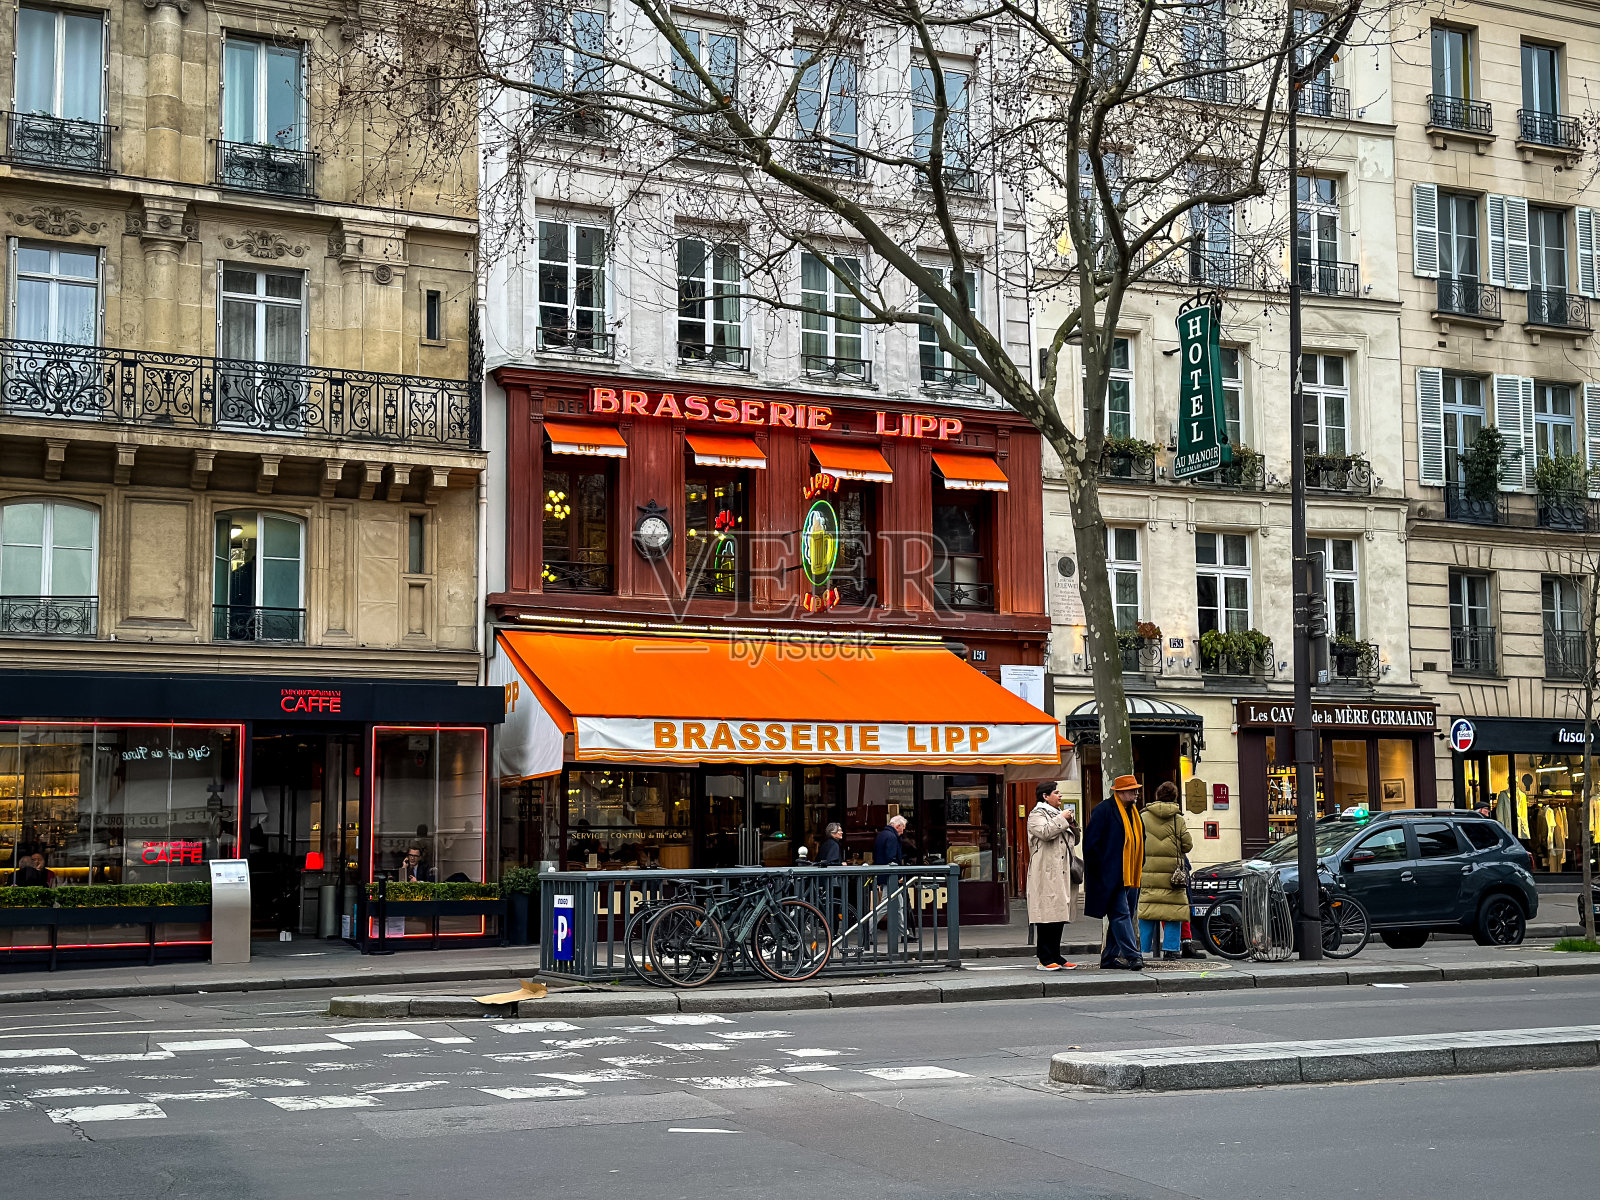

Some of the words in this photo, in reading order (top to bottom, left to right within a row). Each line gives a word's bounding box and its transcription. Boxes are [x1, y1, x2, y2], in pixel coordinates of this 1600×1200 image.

[1187, 316, 1203, 443] HOTEL
[592, 387, 833, 431] BRASSERIE
[875, 411, 963, 440] LIPP
[577, 444, 601, 453] LIPP
[1176, 456, 1186, 469] AU
[1188, 447, 1218, 466] MANOIR
[719, 456, 742, 464] LIPP
[1170, 639, 1182, 648] 153
[973, 650, 986, 660] 151
[505, 681, 519, 714] PP
[1250, 706, 1268, 722] Les
[1270, 707, 1295, 723] CAV
[1312, 713, 1322, 723] de
[1324, 714, 1332, 724] la
[1335, 705, 1369, 725] MÈRE
[1372, 709, 1434, 726] GERMAINE
[653, 721, 880, 751] BRASSERIE
[907, 726, 990, 752] LIPP
[1220, 787, 1227, 795] H
[558, 915, 568, 952] P
